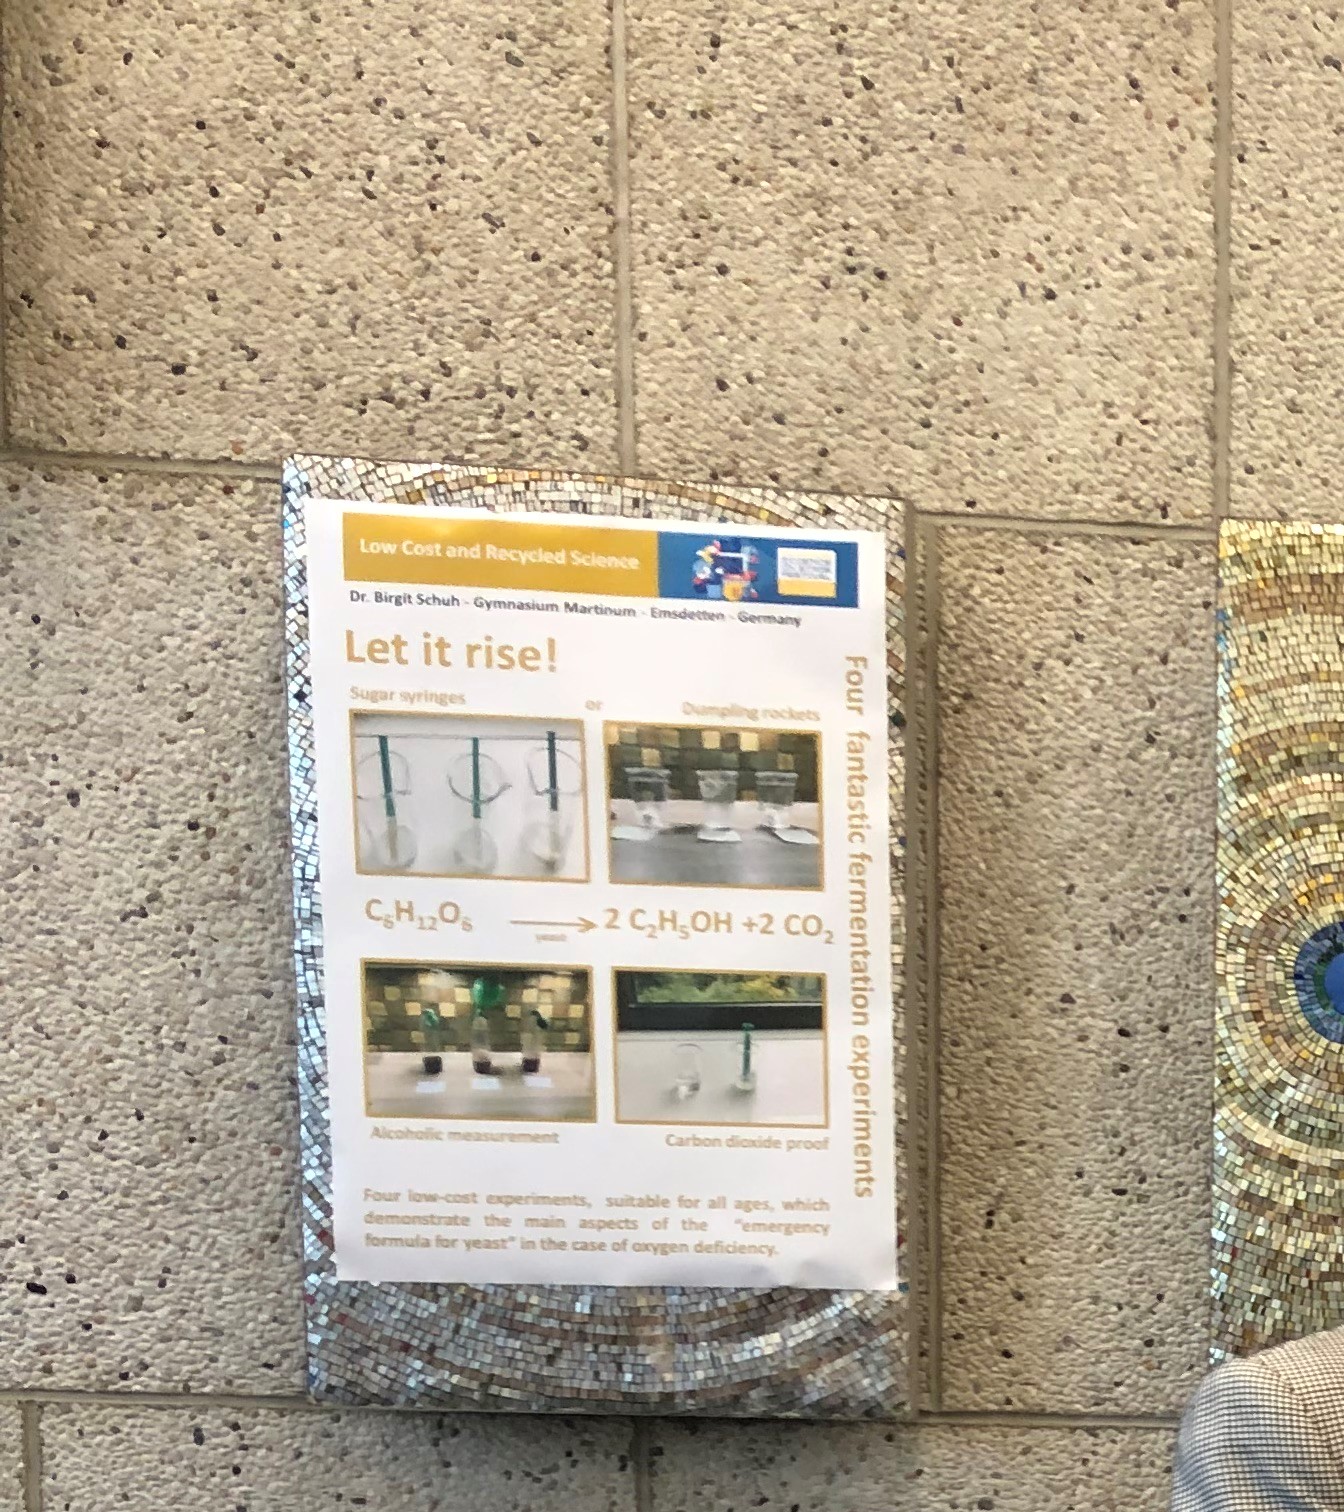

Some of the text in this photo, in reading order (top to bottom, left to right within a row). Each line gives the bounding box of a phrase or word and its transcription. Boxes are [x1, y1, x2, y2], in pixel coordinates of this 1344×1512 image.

[360, 538, 640, 570] Low Cost and Recycled Science
[350, 590, 802, 627] Dr. Birgit Schuh Gymnasium Martinum Emsdetten Germany
[346, 629, 557, 673] Let it rise!
[604, 907, 621, 930] 2
[845, 655, 877, 1199] Four fantastic fermentation experiments
[665, 1133, 723, 1149] Carbon
[786, 1136, 830, 1152] proof
